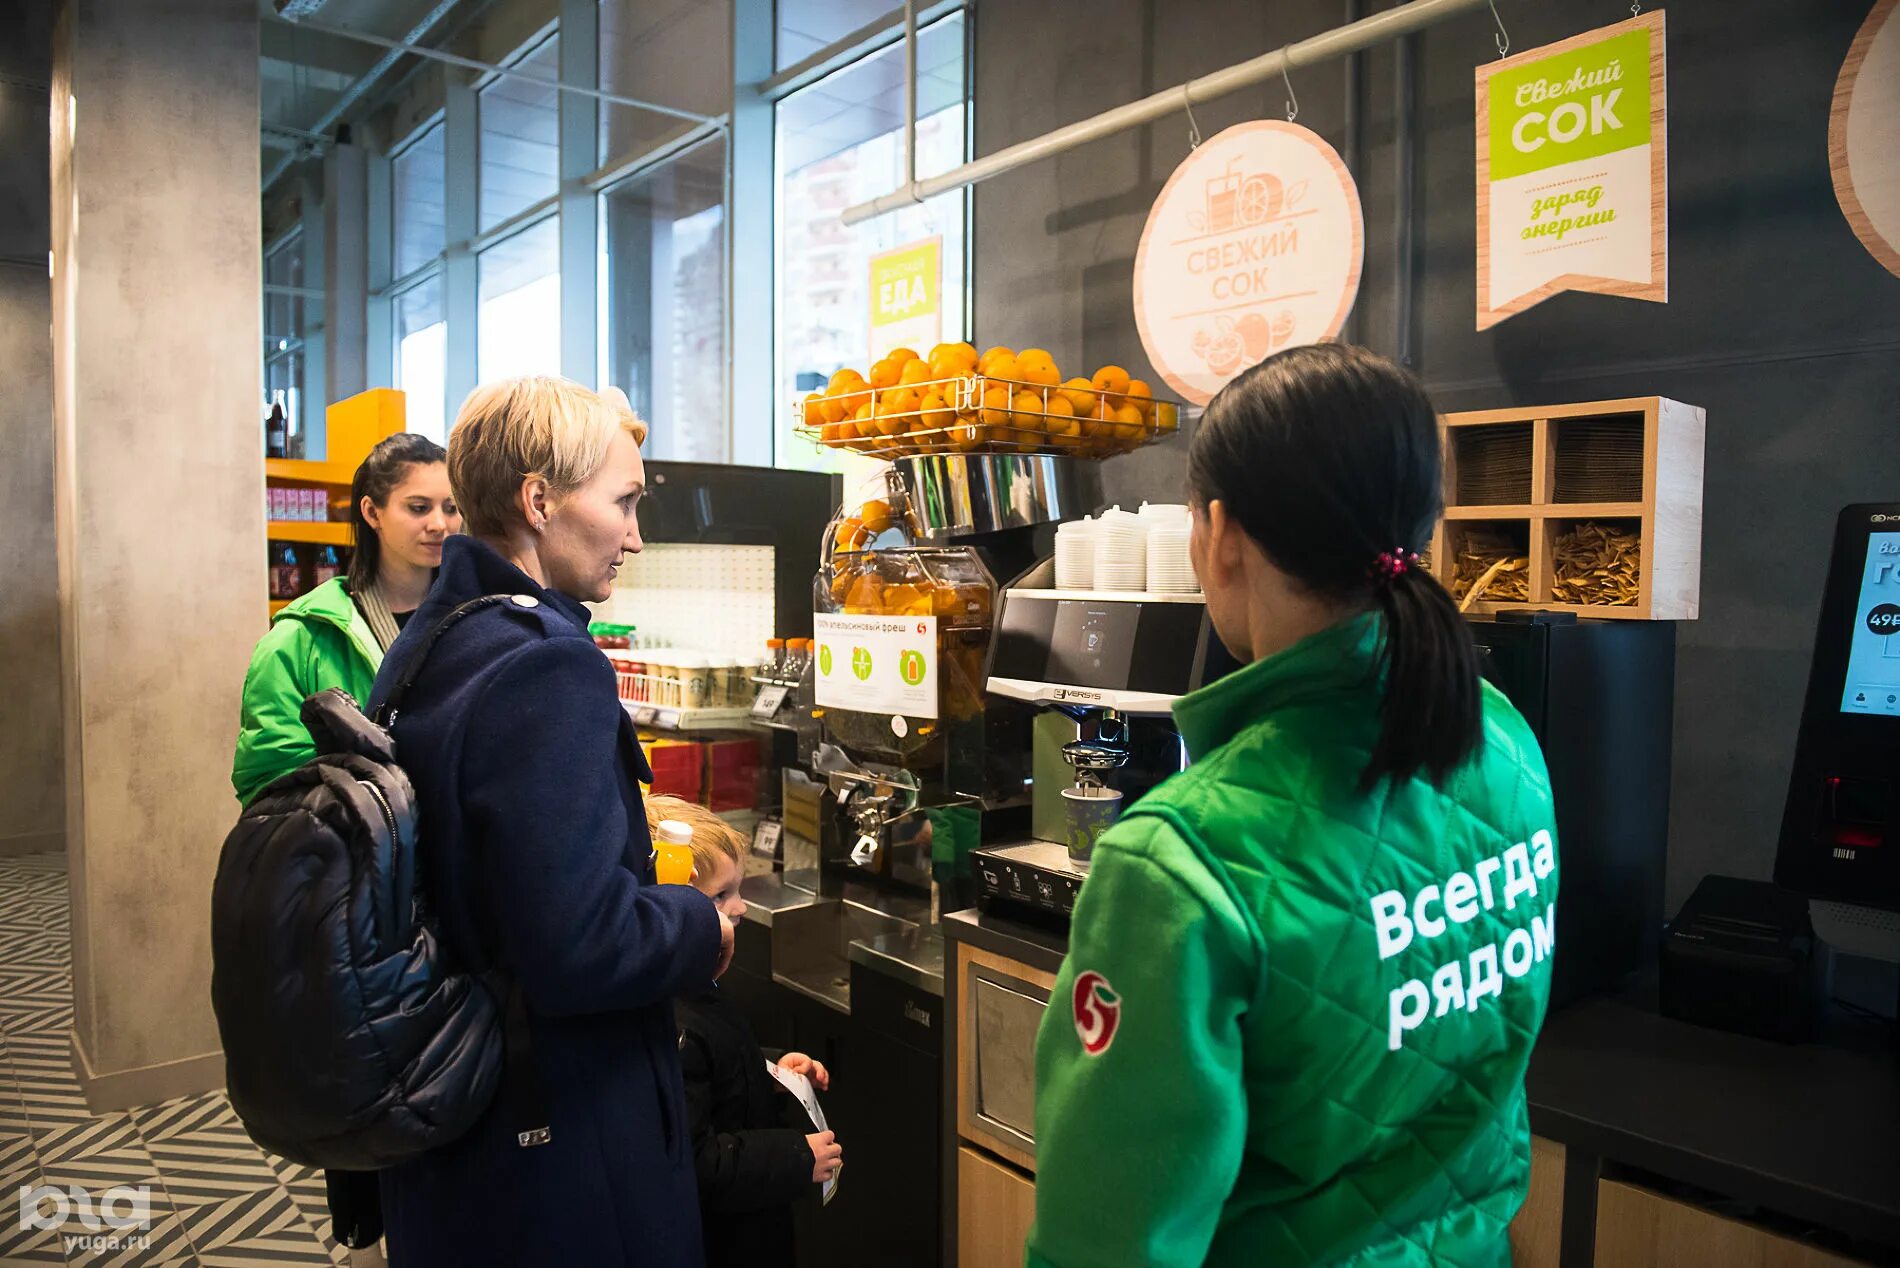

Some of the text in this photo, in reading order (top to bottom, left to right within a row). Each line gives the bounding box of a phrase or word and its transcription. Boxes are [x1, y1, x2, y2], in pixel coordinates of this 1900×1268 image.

[1515, 59, 1624, 107] Свежий
[1512, 88, 1624, 153] СОК
[1520, 208, 1617, 241] энергии
[1530, 185, 1605, 221] заряд
[1187, 222, 1299, 274] СВЕЖИЙ
[880, 275, 927, 316] ЕДА
[1212, 267, 1269, 300] СОК
[830, 620, 880, 632] апельсиновый
[881, 623, 906, 633] фреш
[1370, 829, 1554, 960] Всегда
[1388, 902, 1554, 1051] рядом
